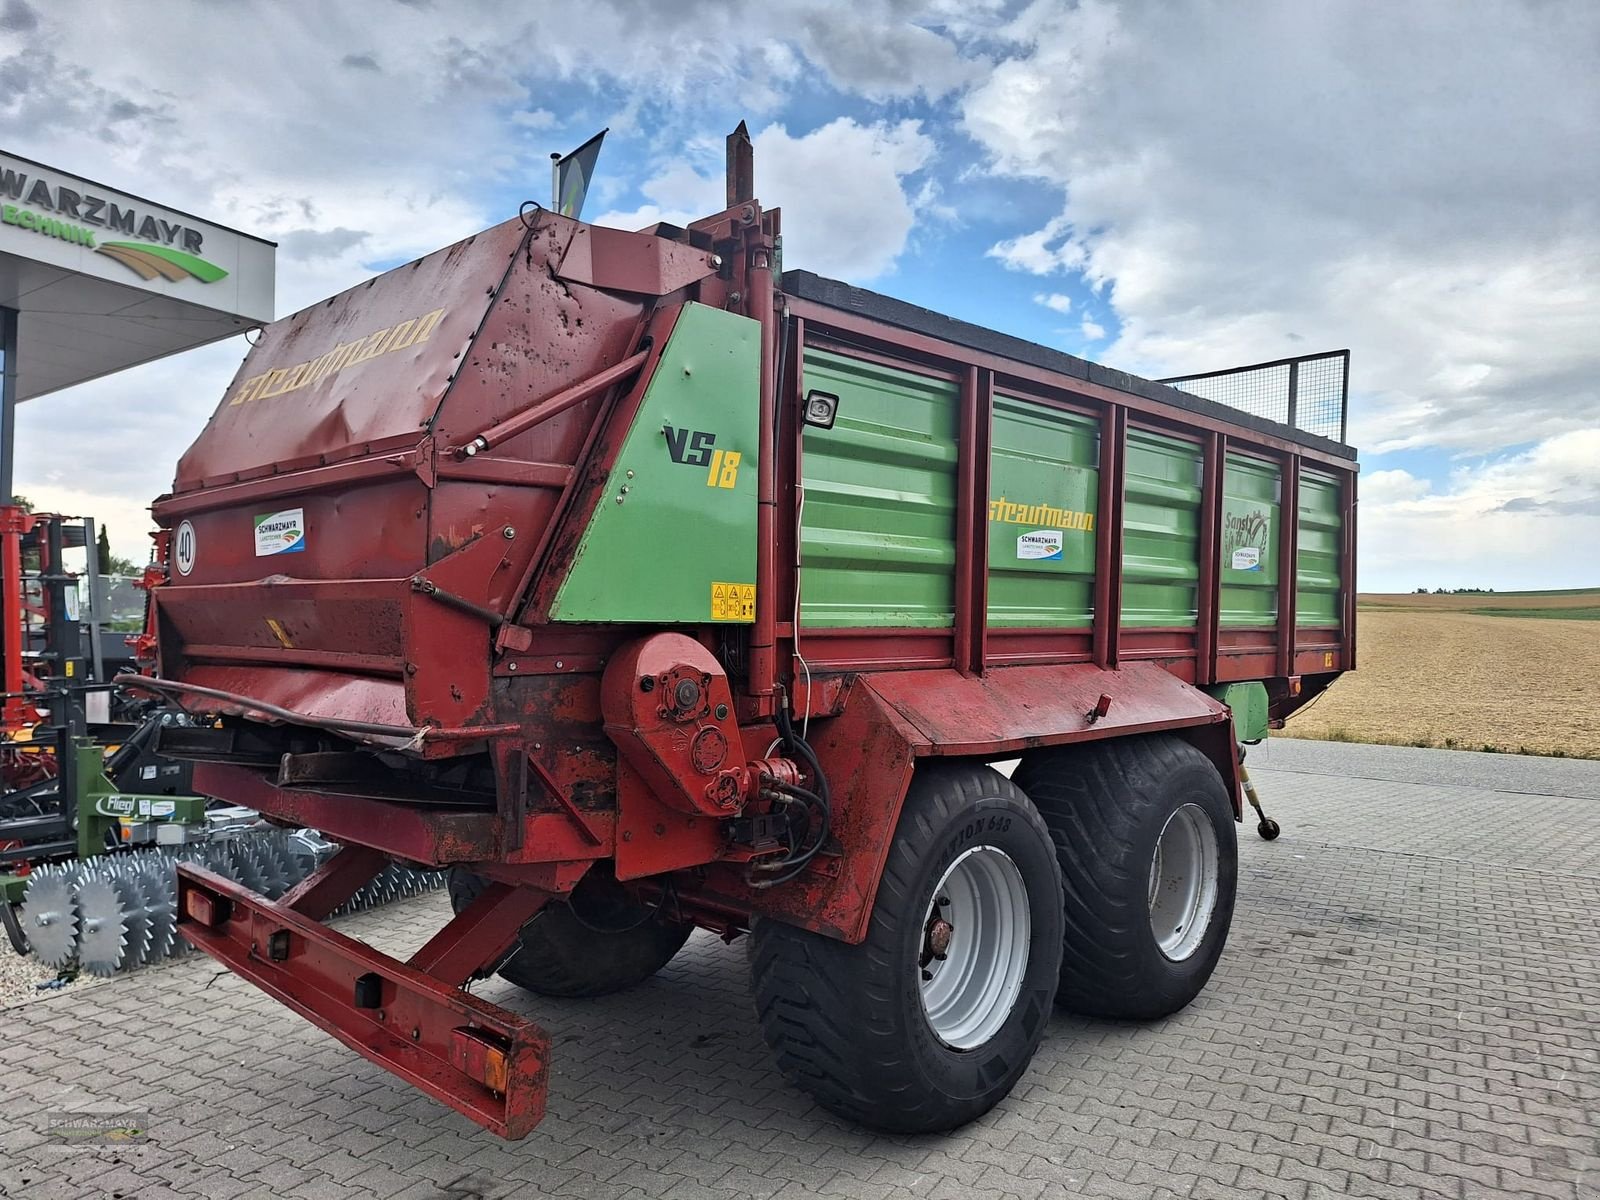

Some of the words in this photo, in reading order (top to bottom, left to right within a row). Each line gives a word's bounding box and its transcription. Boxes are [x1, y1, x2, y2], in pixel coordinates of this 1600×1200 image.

[2, 204, 97, 248] ECHNIK
[663, 425, 716, 467] VS
[707, 449, 742, 489] 18
[259, 520, 297, 534] SCHWARZMAYR
[988, 496, 1094, 531] strautmann
[179, 531, 191, 563] 40
[107, 795, 136, 814] Fliegl
